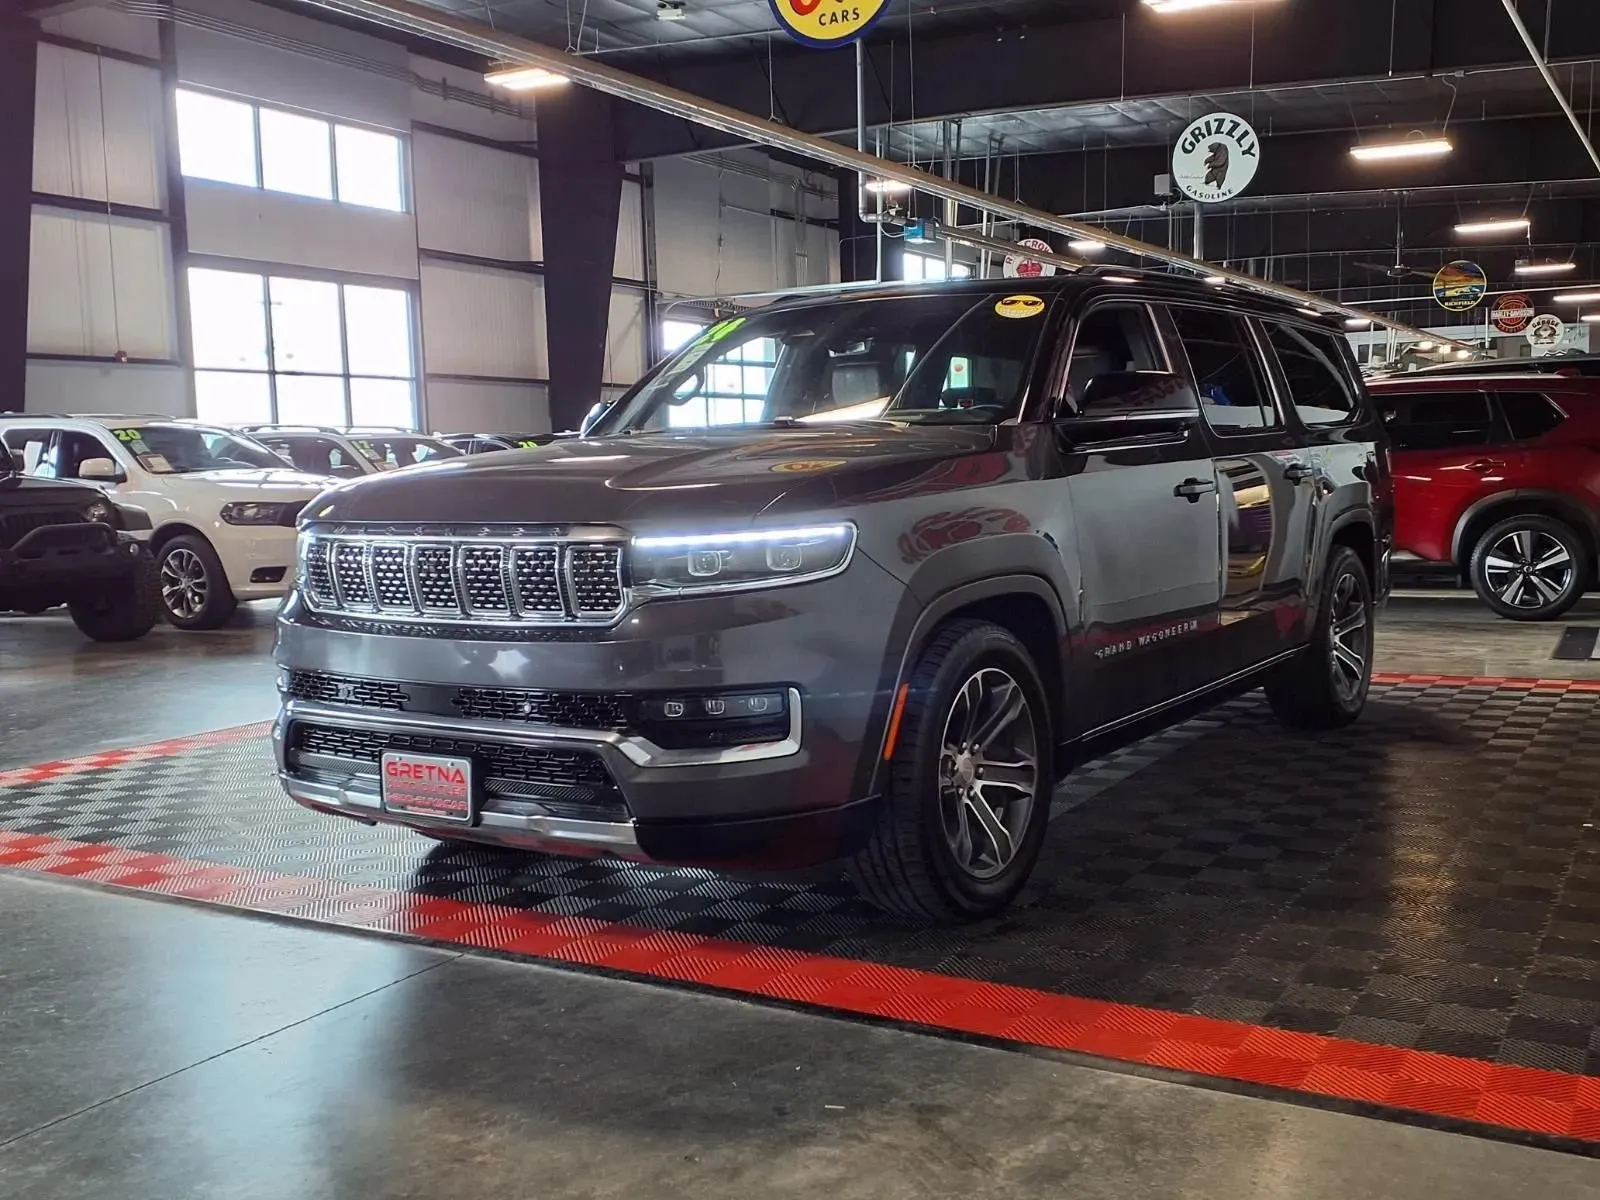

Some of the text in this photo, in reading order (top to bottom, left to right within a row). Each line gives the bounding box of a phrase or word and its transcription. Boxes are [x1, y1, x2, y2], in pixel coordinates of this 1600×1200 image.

[818, 8, 860, 26] CARS
[1181, 118, 1256, 157] GRIZZLY
[1186, 185, 1234, 199] GASOLINE
[1024, 240, 1051, 253] CRO
[113, 429, 141, 440] 20
[1096, 622, 1189, 659] GRAND WAGONEER
[386, 761, 466, 784] GRETNA
